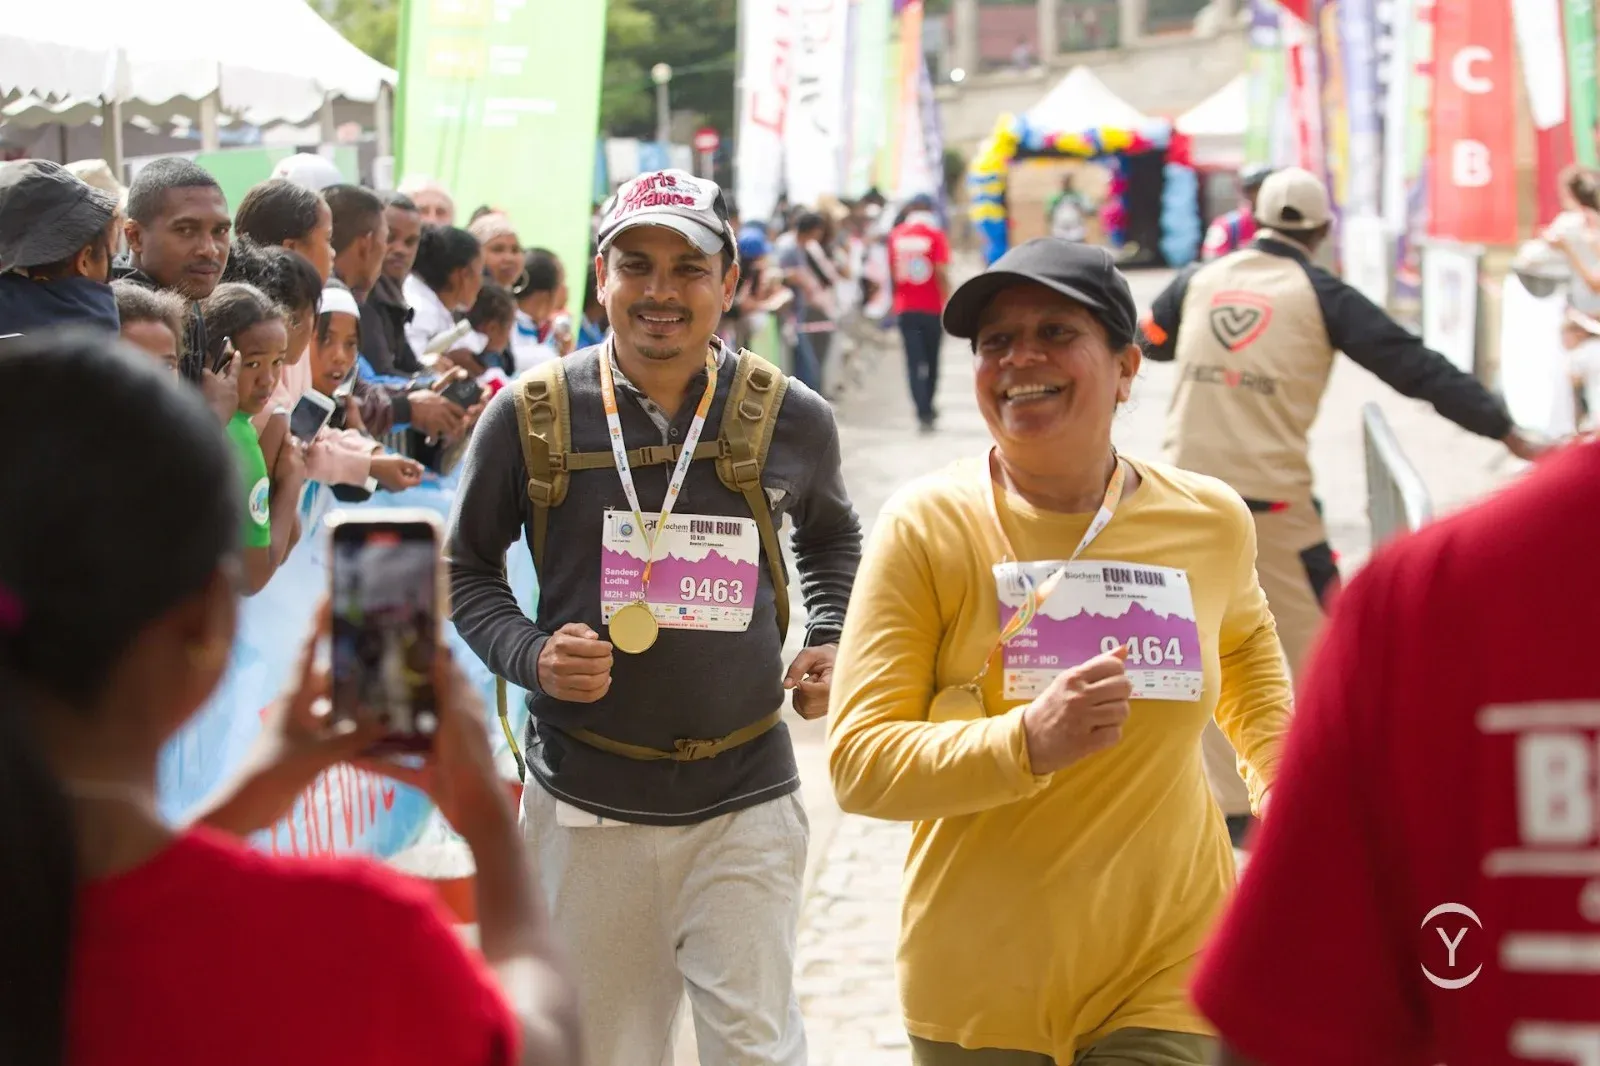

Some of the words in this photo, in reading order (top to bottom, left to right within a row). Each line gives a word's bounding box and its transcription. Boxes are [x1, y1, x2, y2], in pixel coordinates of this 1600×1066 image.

[690, 520, 714, 534] FUN
[716, 521, 742, 537] RUN
[604, 568, 639, 577] Sandeep
[1102, 567, 1131, 584] FUN
[1134, 570, 1166, 587] RUN
[604, 577, 630, 585] Lodha
[604, 590, 623, 598] M2H
[629, 591, 646, 599] IND
[679, 575, 743, 604] 9463
[1006, 638, 1038, 648] Lodha
[1100, 636, 1184, 665] 9464
[1007, 655, 1030, 665] M1F
[1039, 655, 1059, 665] IND
